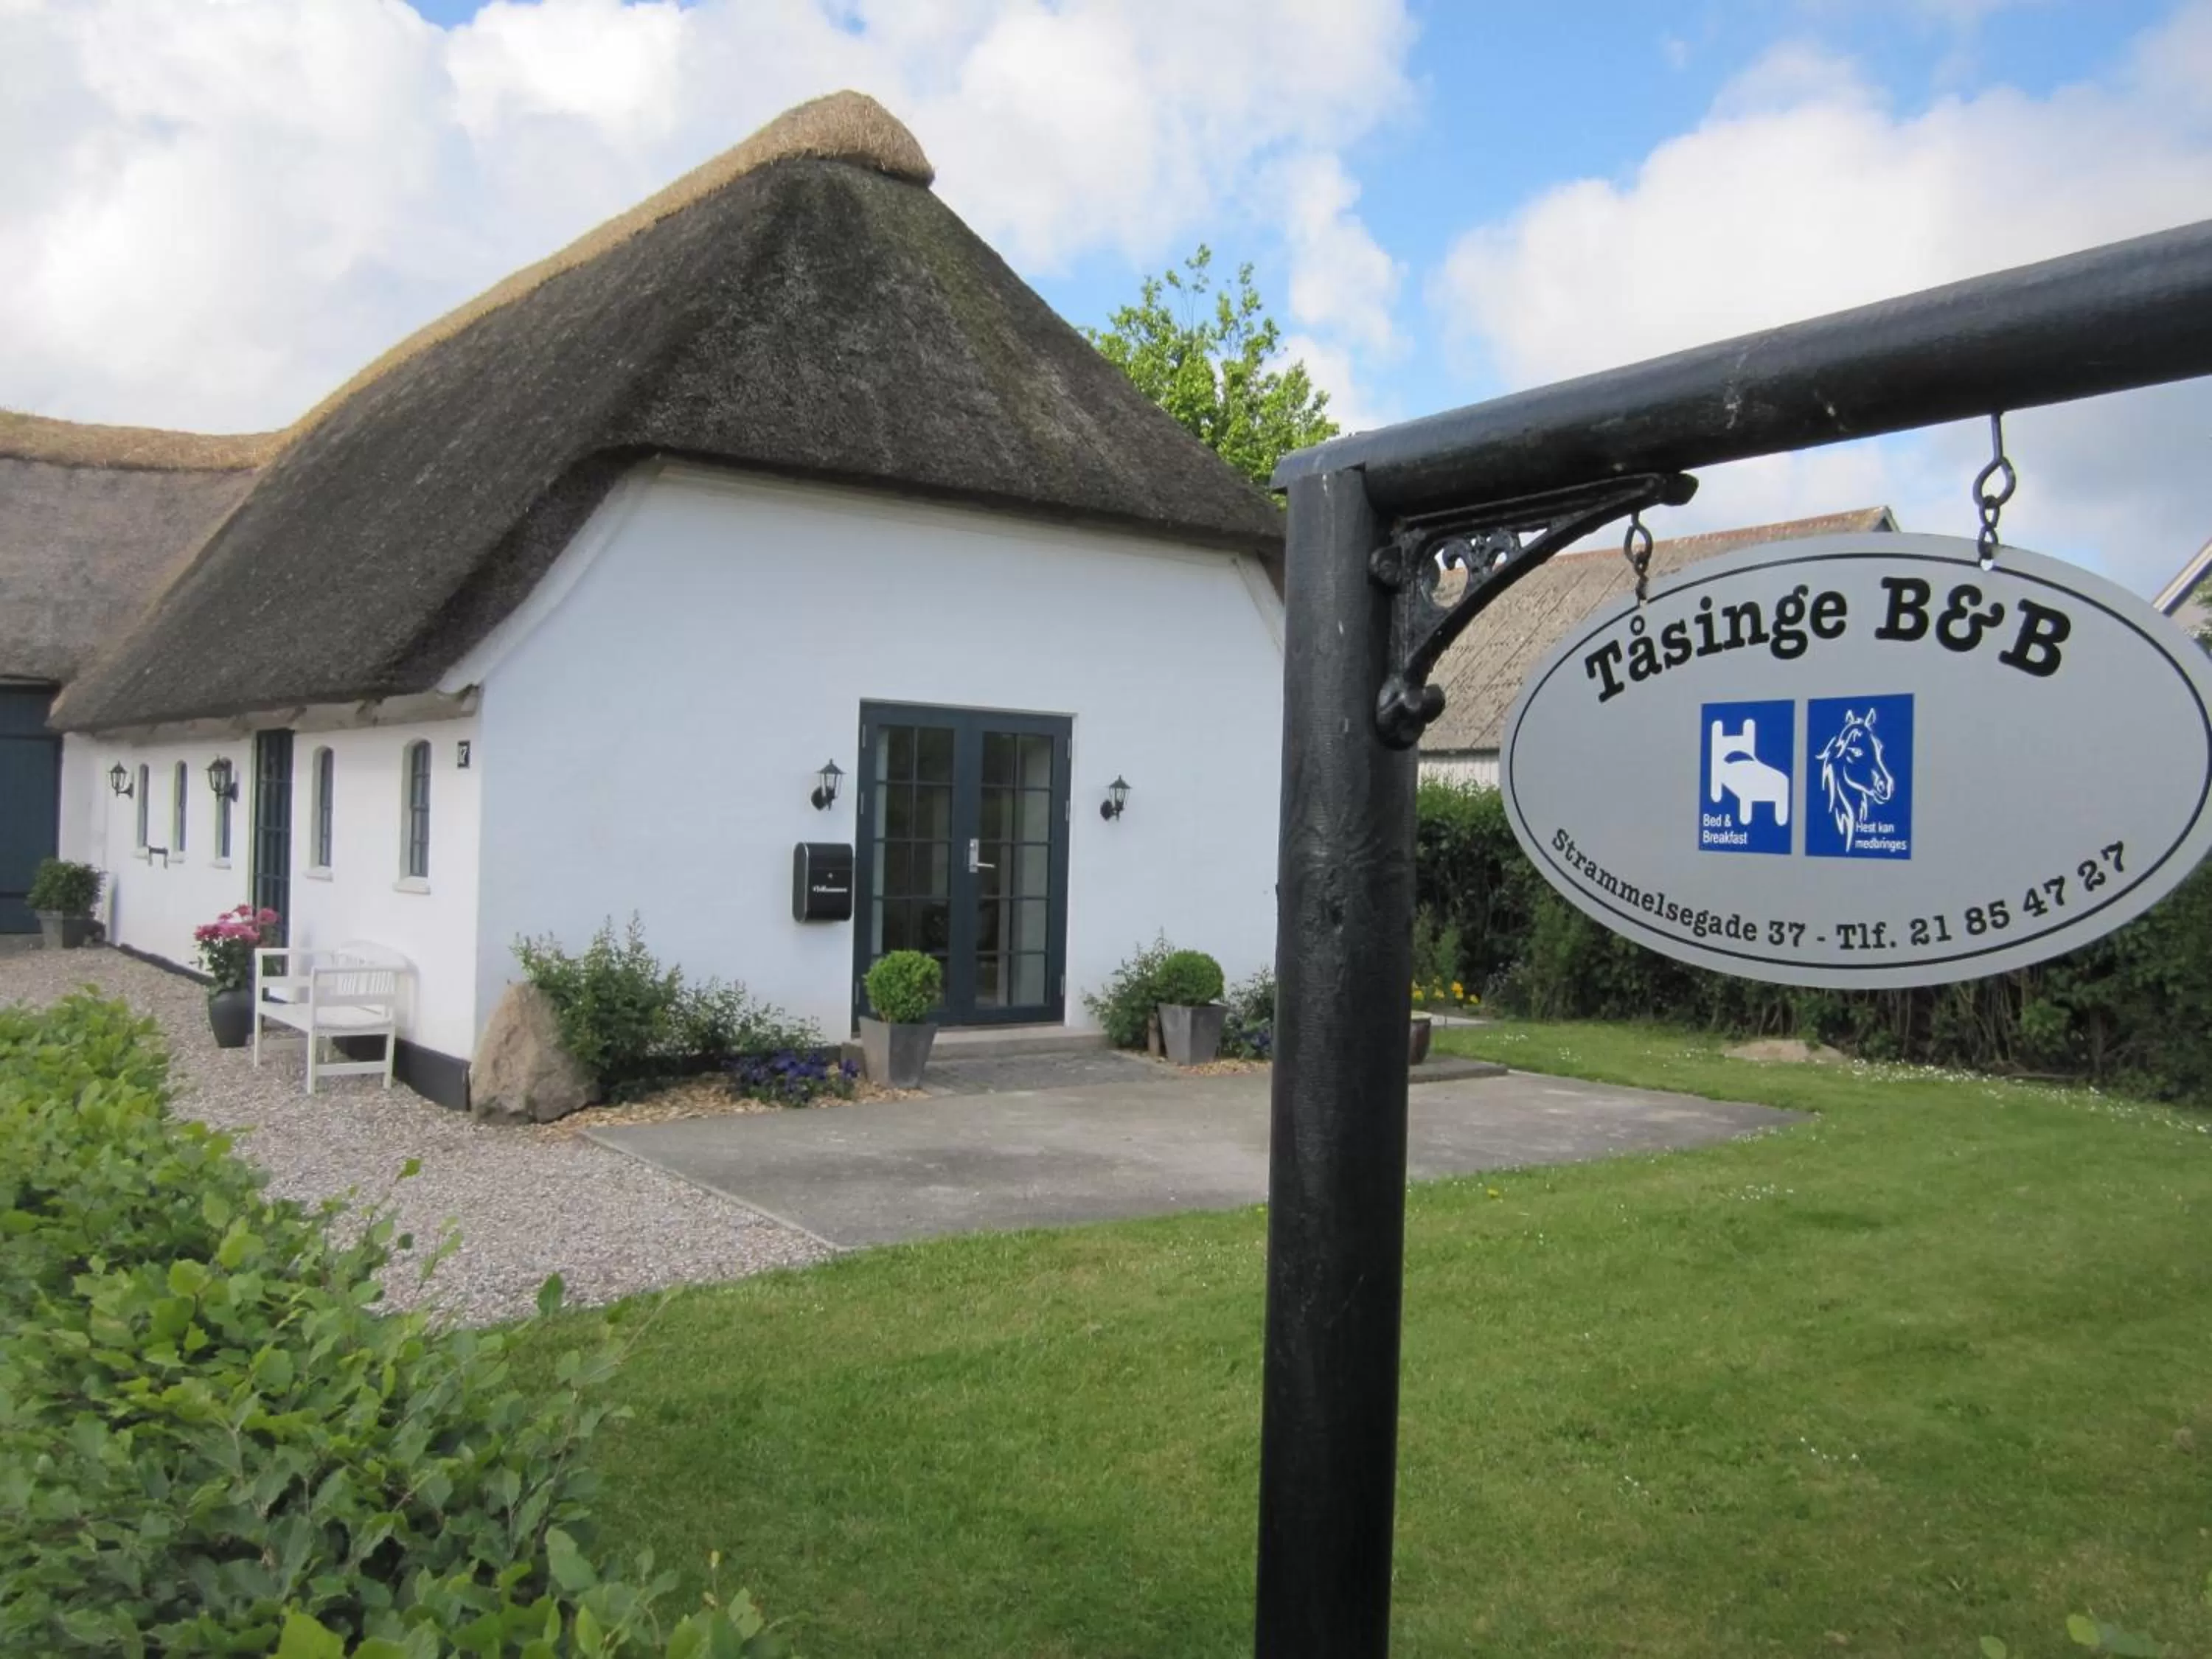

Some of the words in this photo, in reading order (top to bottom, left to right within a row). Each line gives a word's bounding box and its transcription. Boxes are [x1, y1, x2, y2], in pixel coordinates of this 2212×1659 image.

[1585, 585, 1847, 703] Tåsinge
[1874, 577, 2071, 678] B&B
[1703, 813, 1722, 827] Bed
[1724, 814, 1732, 827] &
[1855, 821, 1877, 834] Hest
[1879, 822, 1894, 833] kan
[1702, 830, 1747, 844] Breakfast
[1854, 837, 1907, 853] medbringes
[1551, 828, 1757, 942] Strammelsegade
[1767, 920, 1806, 948] 37
[1836, 921, 1896, 950] Tlf.
[1910, 914, 1952, 946] 21
[1964, 900, 2010, 936] 85
[2023, 875, 2065, 917] 47
[2077, 841, 2124, 892] 27
